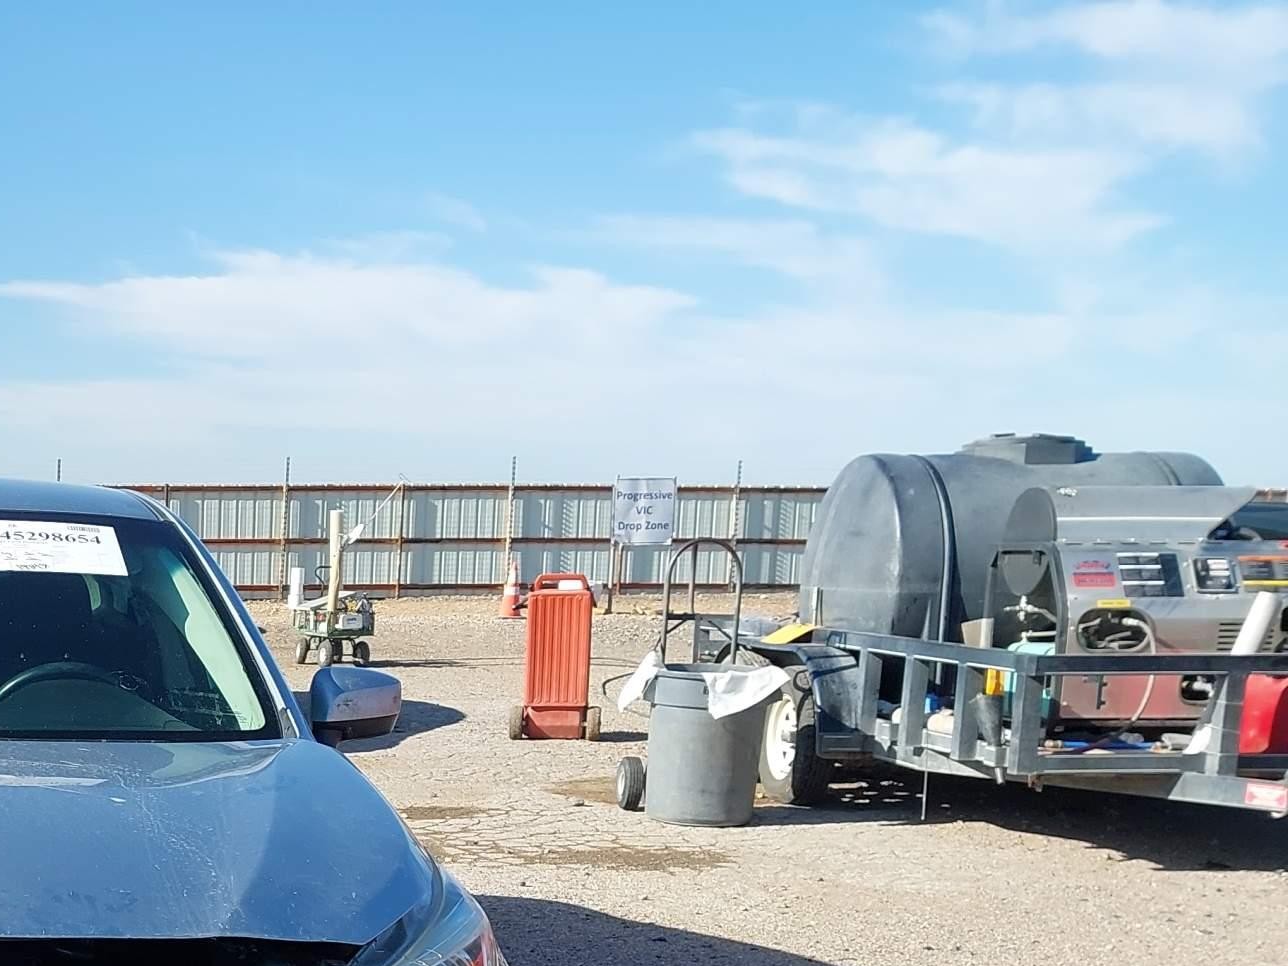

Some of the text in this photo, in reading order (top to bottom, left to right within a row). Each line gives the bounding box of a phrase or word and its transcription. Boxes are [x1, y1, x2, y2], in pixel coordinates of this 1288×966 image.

[616, 490, 673, 502] Progressive
[635, 505, 654, 515] VIC
[617, 521, 670, 532] Drop Zone
[0, 530, 102, 545] 45298654
